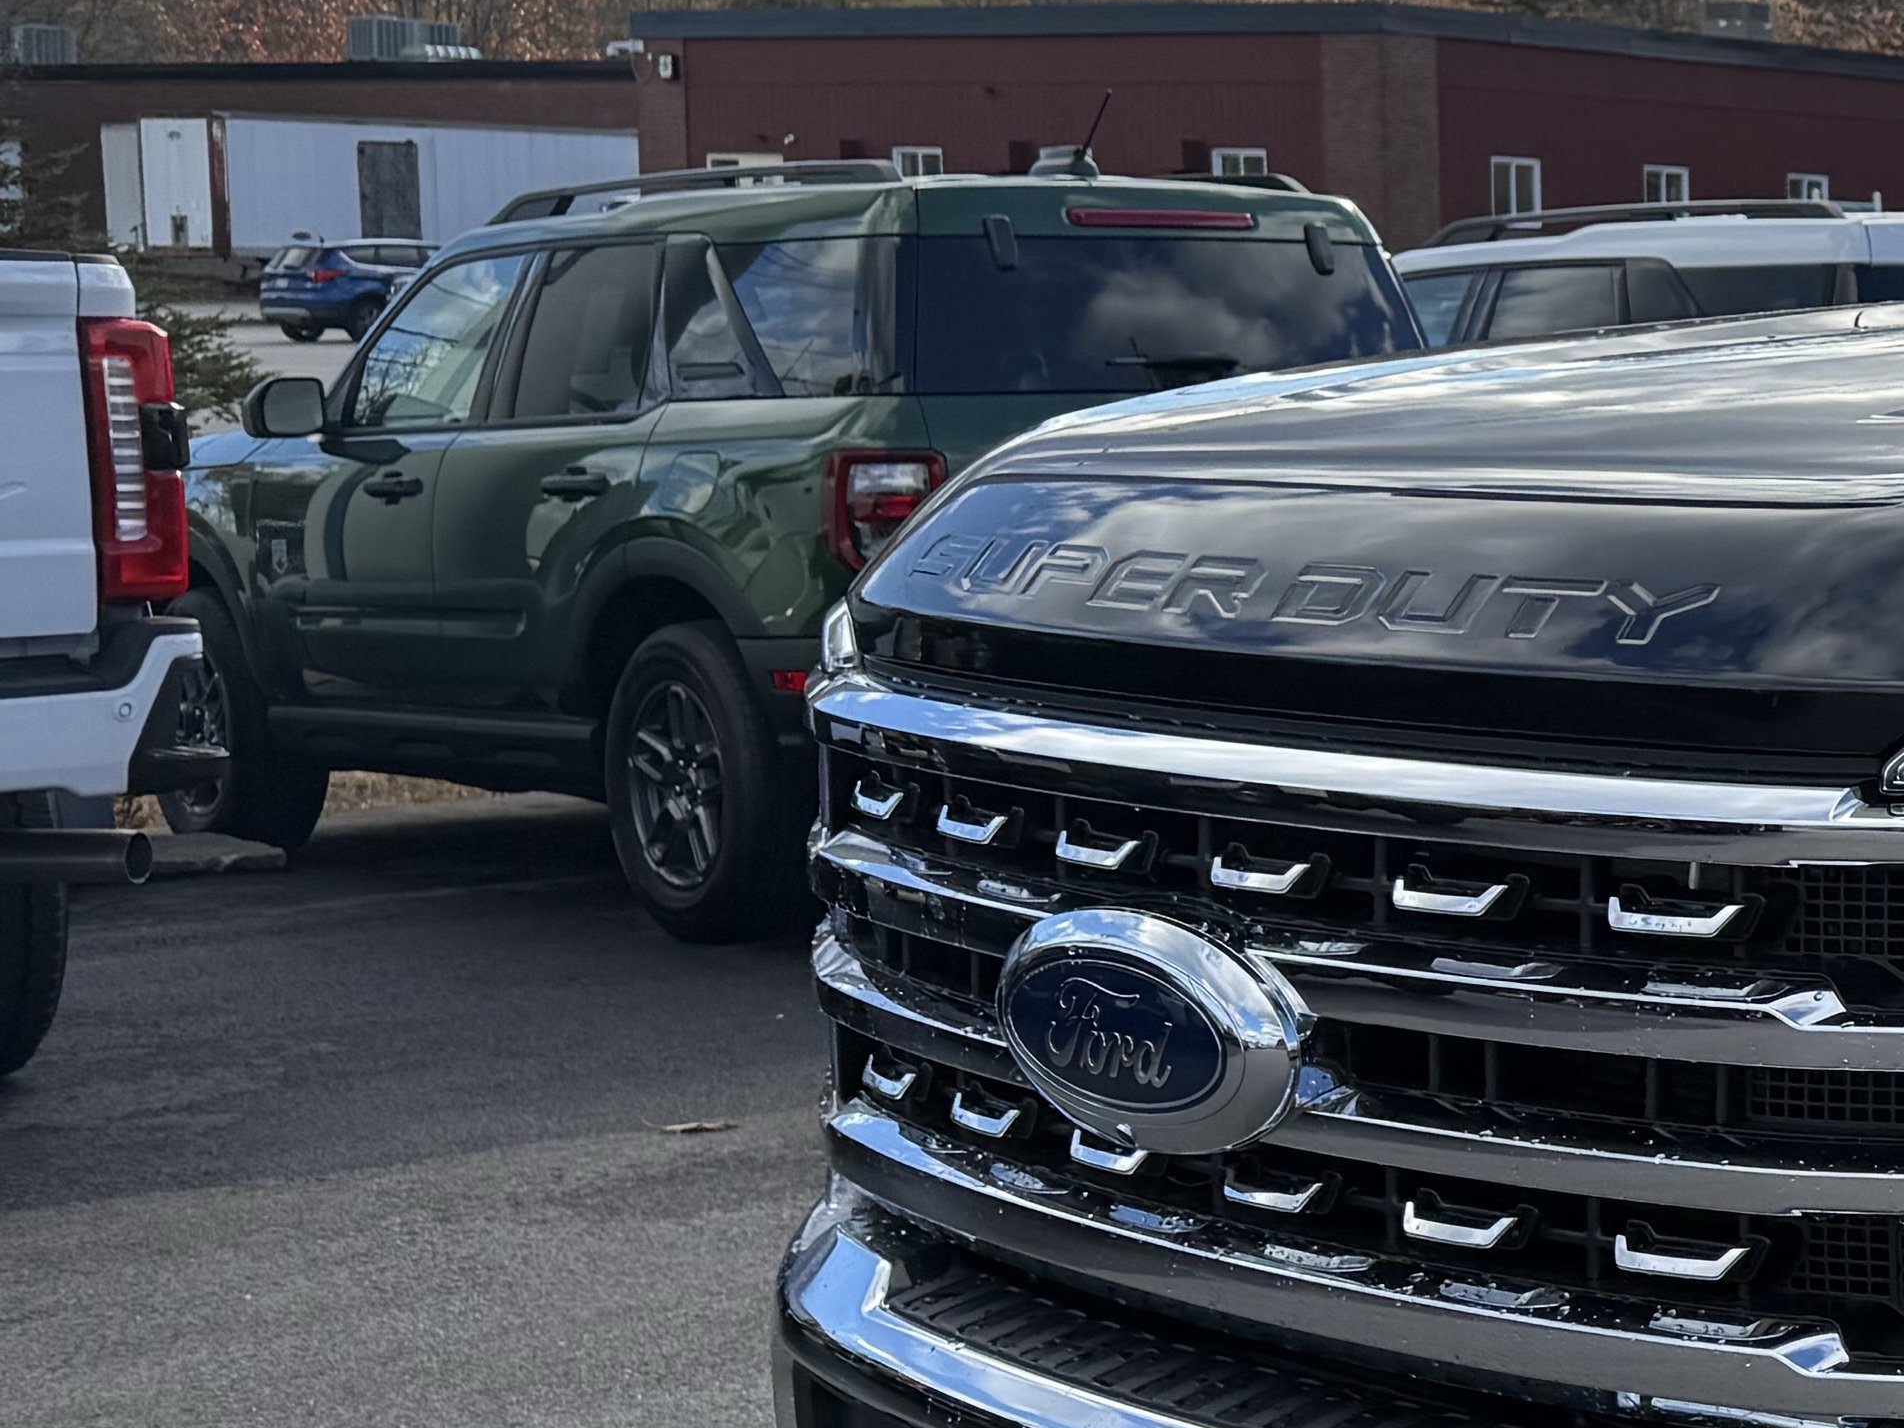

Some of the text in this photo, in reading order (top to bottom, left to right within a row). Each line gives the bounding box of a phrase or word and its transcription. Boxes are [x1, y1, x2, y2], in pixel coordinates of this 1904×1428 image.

[908, 533, 1722, 646] SUPER DUTY
[1045, 976, 1174, 1089] Ford
